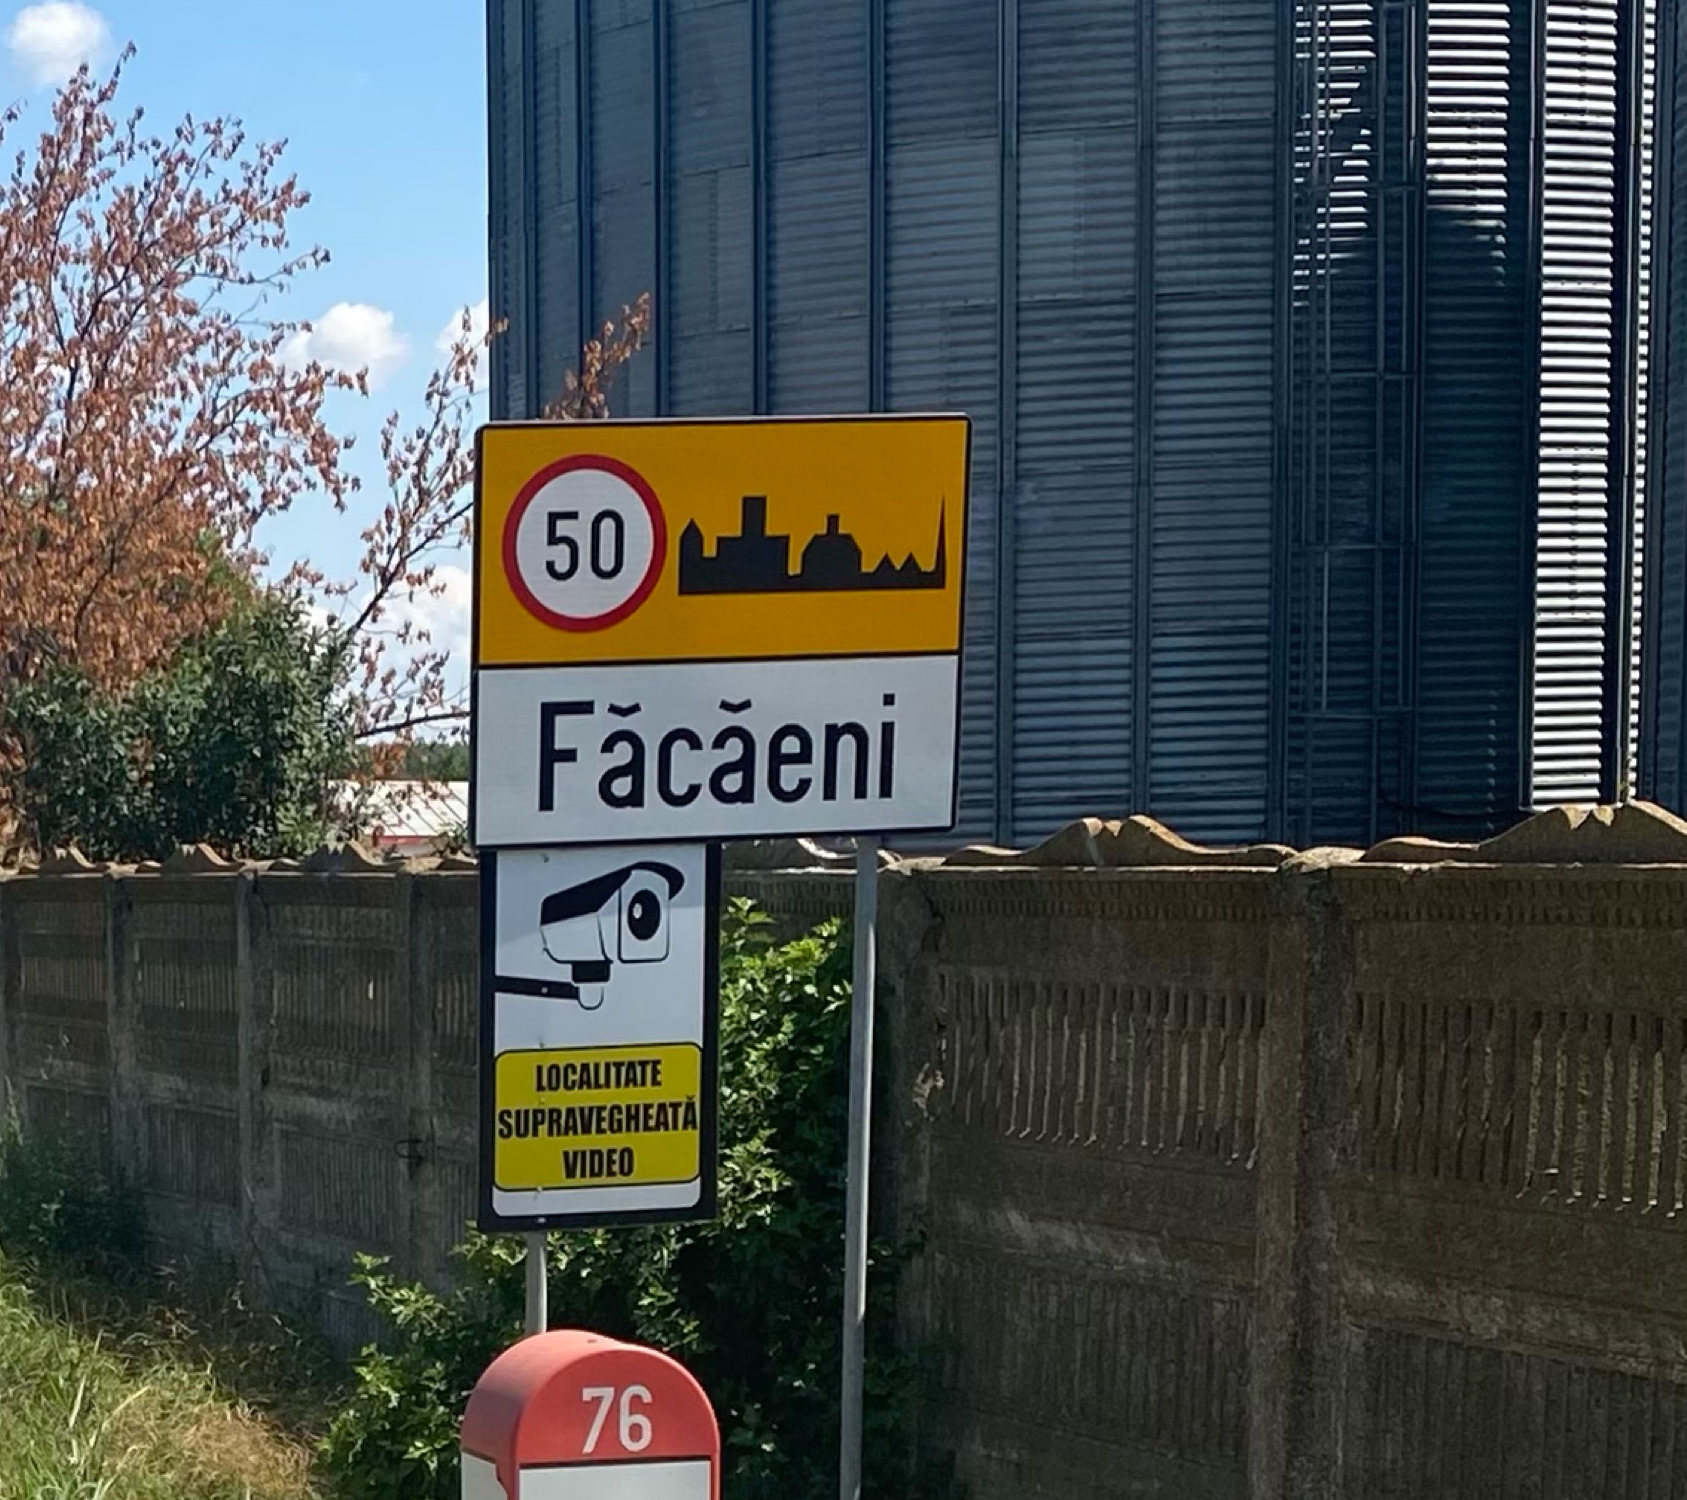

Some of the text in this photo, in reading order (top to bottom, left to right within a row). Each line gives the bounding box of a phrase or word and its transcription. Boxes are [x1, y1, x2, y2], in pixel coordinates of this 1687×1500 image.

[545, 510, 625, 581] 50
[538, 693, 896, 812] Făcăeni
[535, 1058, 663, 1093] LOCALITATE
[497, 1095, 698, 1139] SUPRAVEGHEATĂ
[562, 1146, 635, 1180] VIDEO
[581, 1385, 653, 1454] 76
